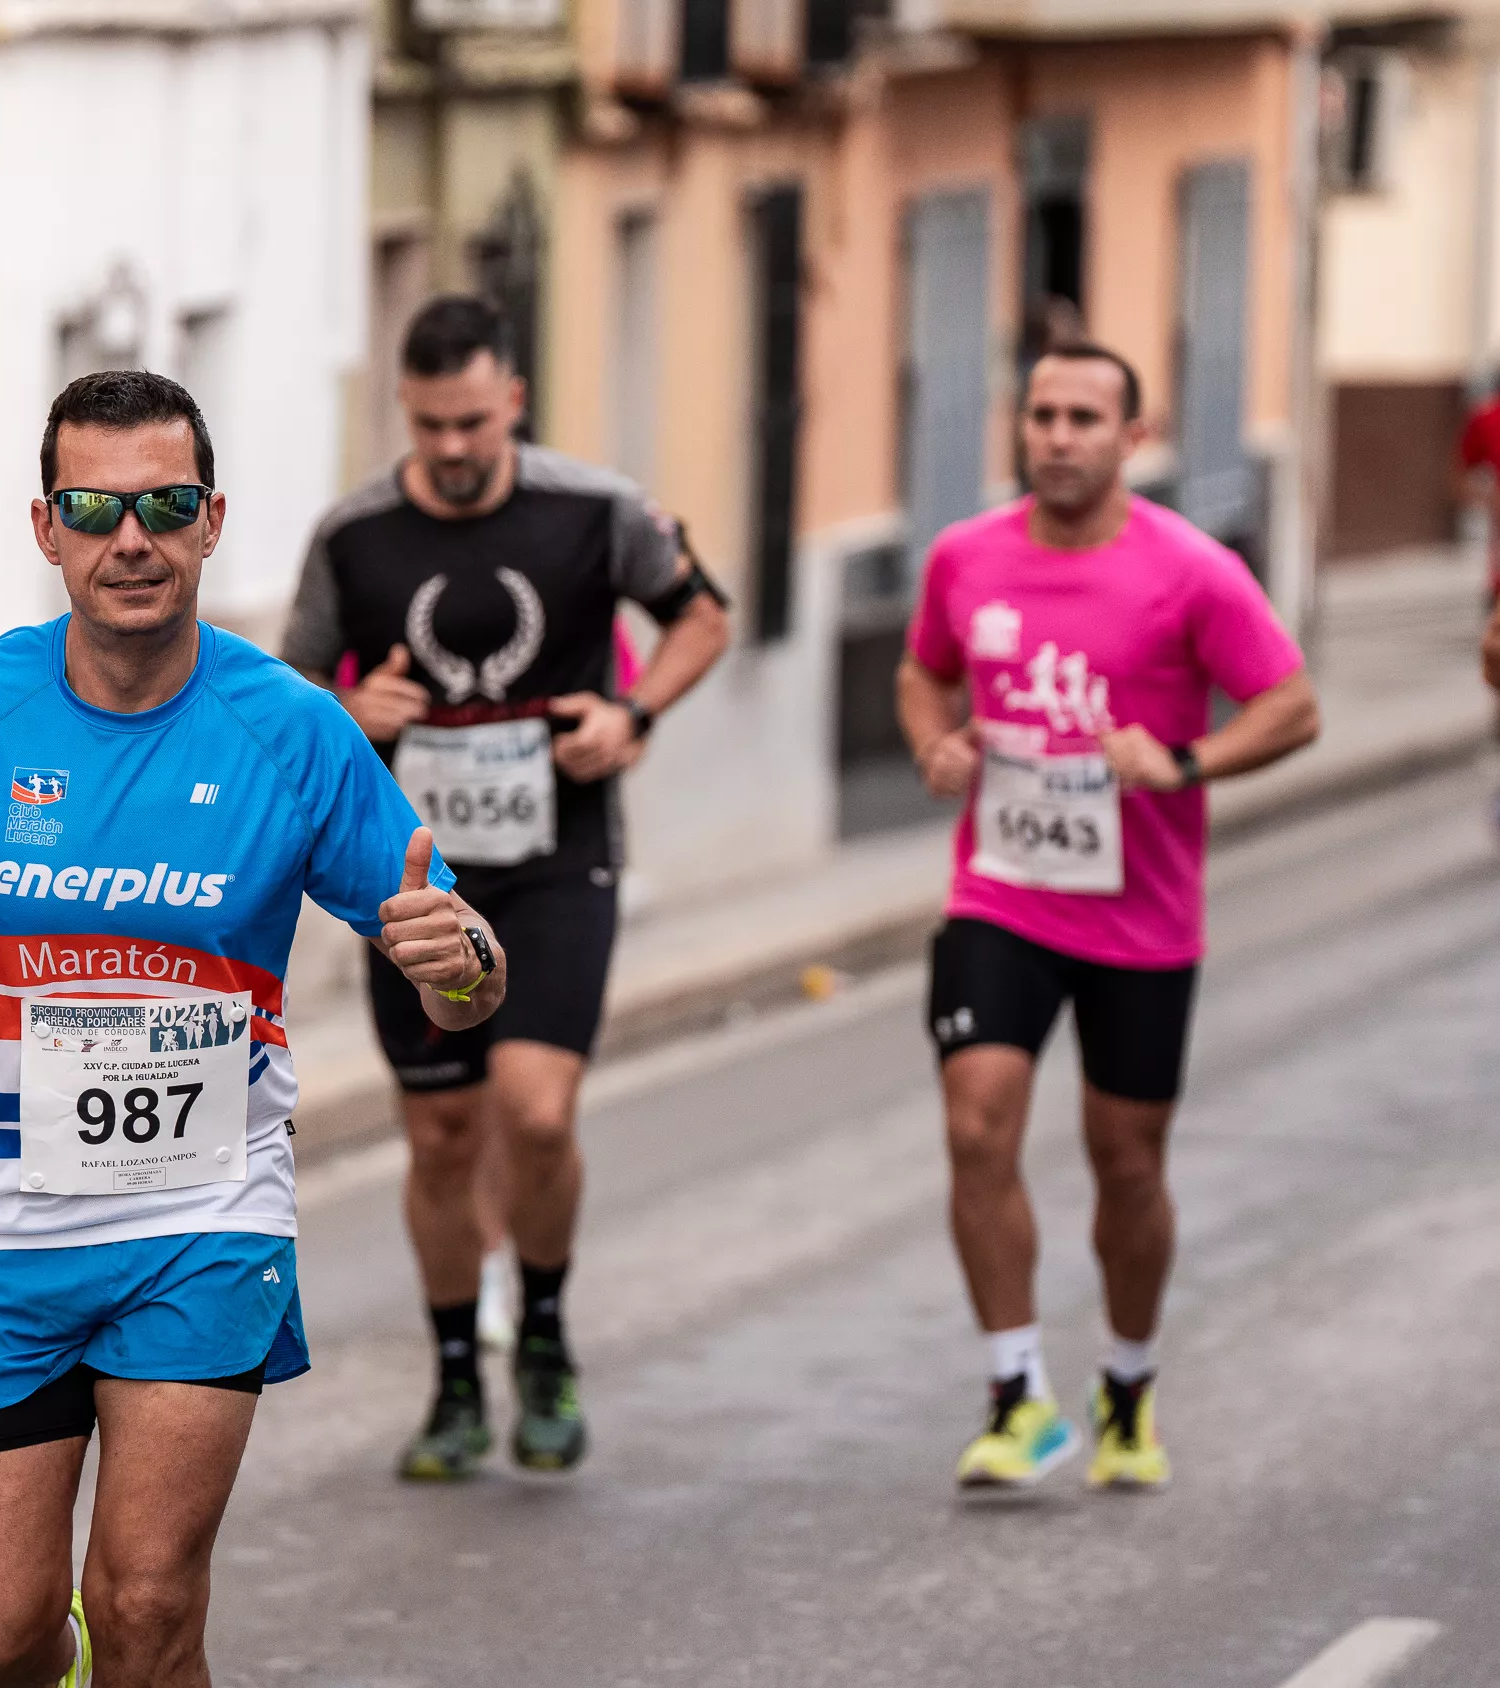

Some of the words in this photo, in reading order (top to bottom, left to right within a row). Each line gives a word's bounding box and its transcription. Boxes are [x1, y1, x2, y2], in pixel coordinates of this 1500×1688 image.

[8, 803, 41, 819] Club
[421, 784, 537, 829] 1056
[7, 817, 63, 833] Maratón
[5, 829, 56, 846] Lucena
[18, 941, 198, 983] Maratón
[30, 1005, 72, 1017] CIRCUITO
[75, 1007, 131, 1018] PROVINCIAL
[134, 1007, 146, 1017] DE
[150, 1004, 207, 1028] 2024
[31, 1015, 84, 1027] CARRERAS
[87, 1017, 146, 1027] POPULARES
[31, 1026, 82, 1036] DTACIÓN
[104, 1027, 147, 1036] CÓRDOBA
[83, 1062, 103, 1070] XXV
[121, 1062, 153, 1070] CIUDAD
[155, 1061, 166, 1069] DE
[168, 1058, 200, 1067] LUCENA
[103, 1074, 120, 1082] POR
[135, 1071, 179, 1081] IGUALDAD
[76, 1081, 204, 1145] 987
[81, 1160, 119, 1168] RAFAEL
[120, 1157, 158, 1167] LOZANO
[160, 1151, 197, 1163] CAMPOS
